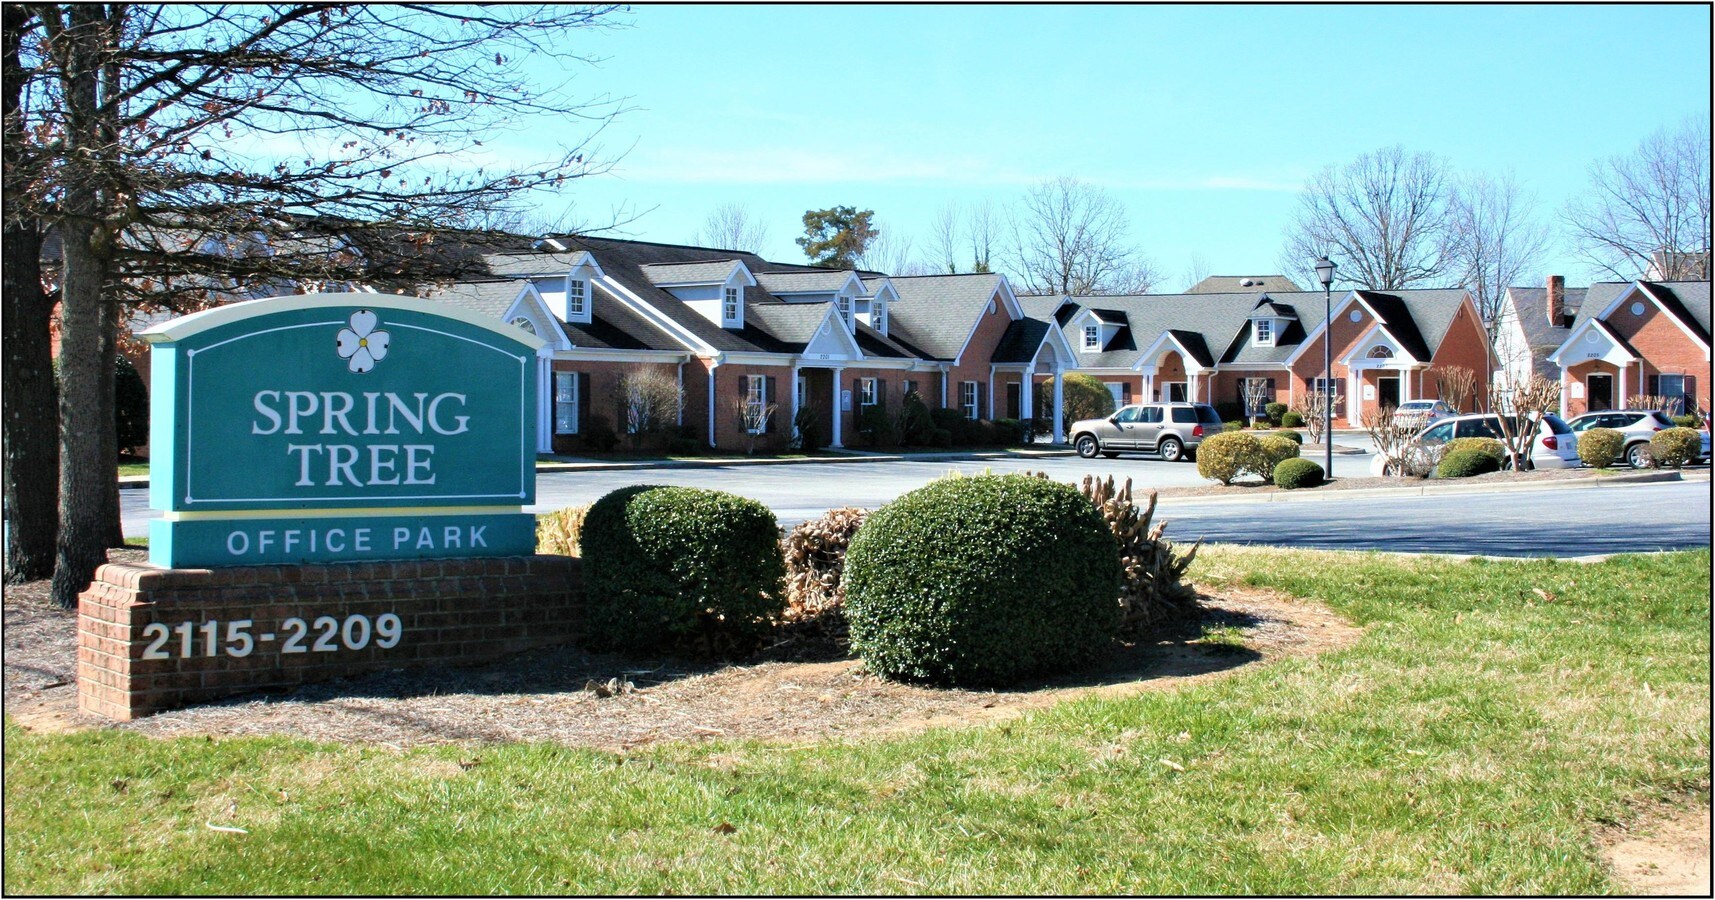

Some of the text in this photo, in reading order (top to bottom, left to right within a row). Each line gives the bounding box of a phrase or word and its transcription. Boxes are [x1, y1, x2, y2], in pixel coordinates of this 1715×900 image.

[251, 390, 470, 436] SPRING
[288, 444, 436, 487] TREE
[227, 525, 488, 556] OFFICE PARK
[142, 613, 402, 661] 2115-2209
